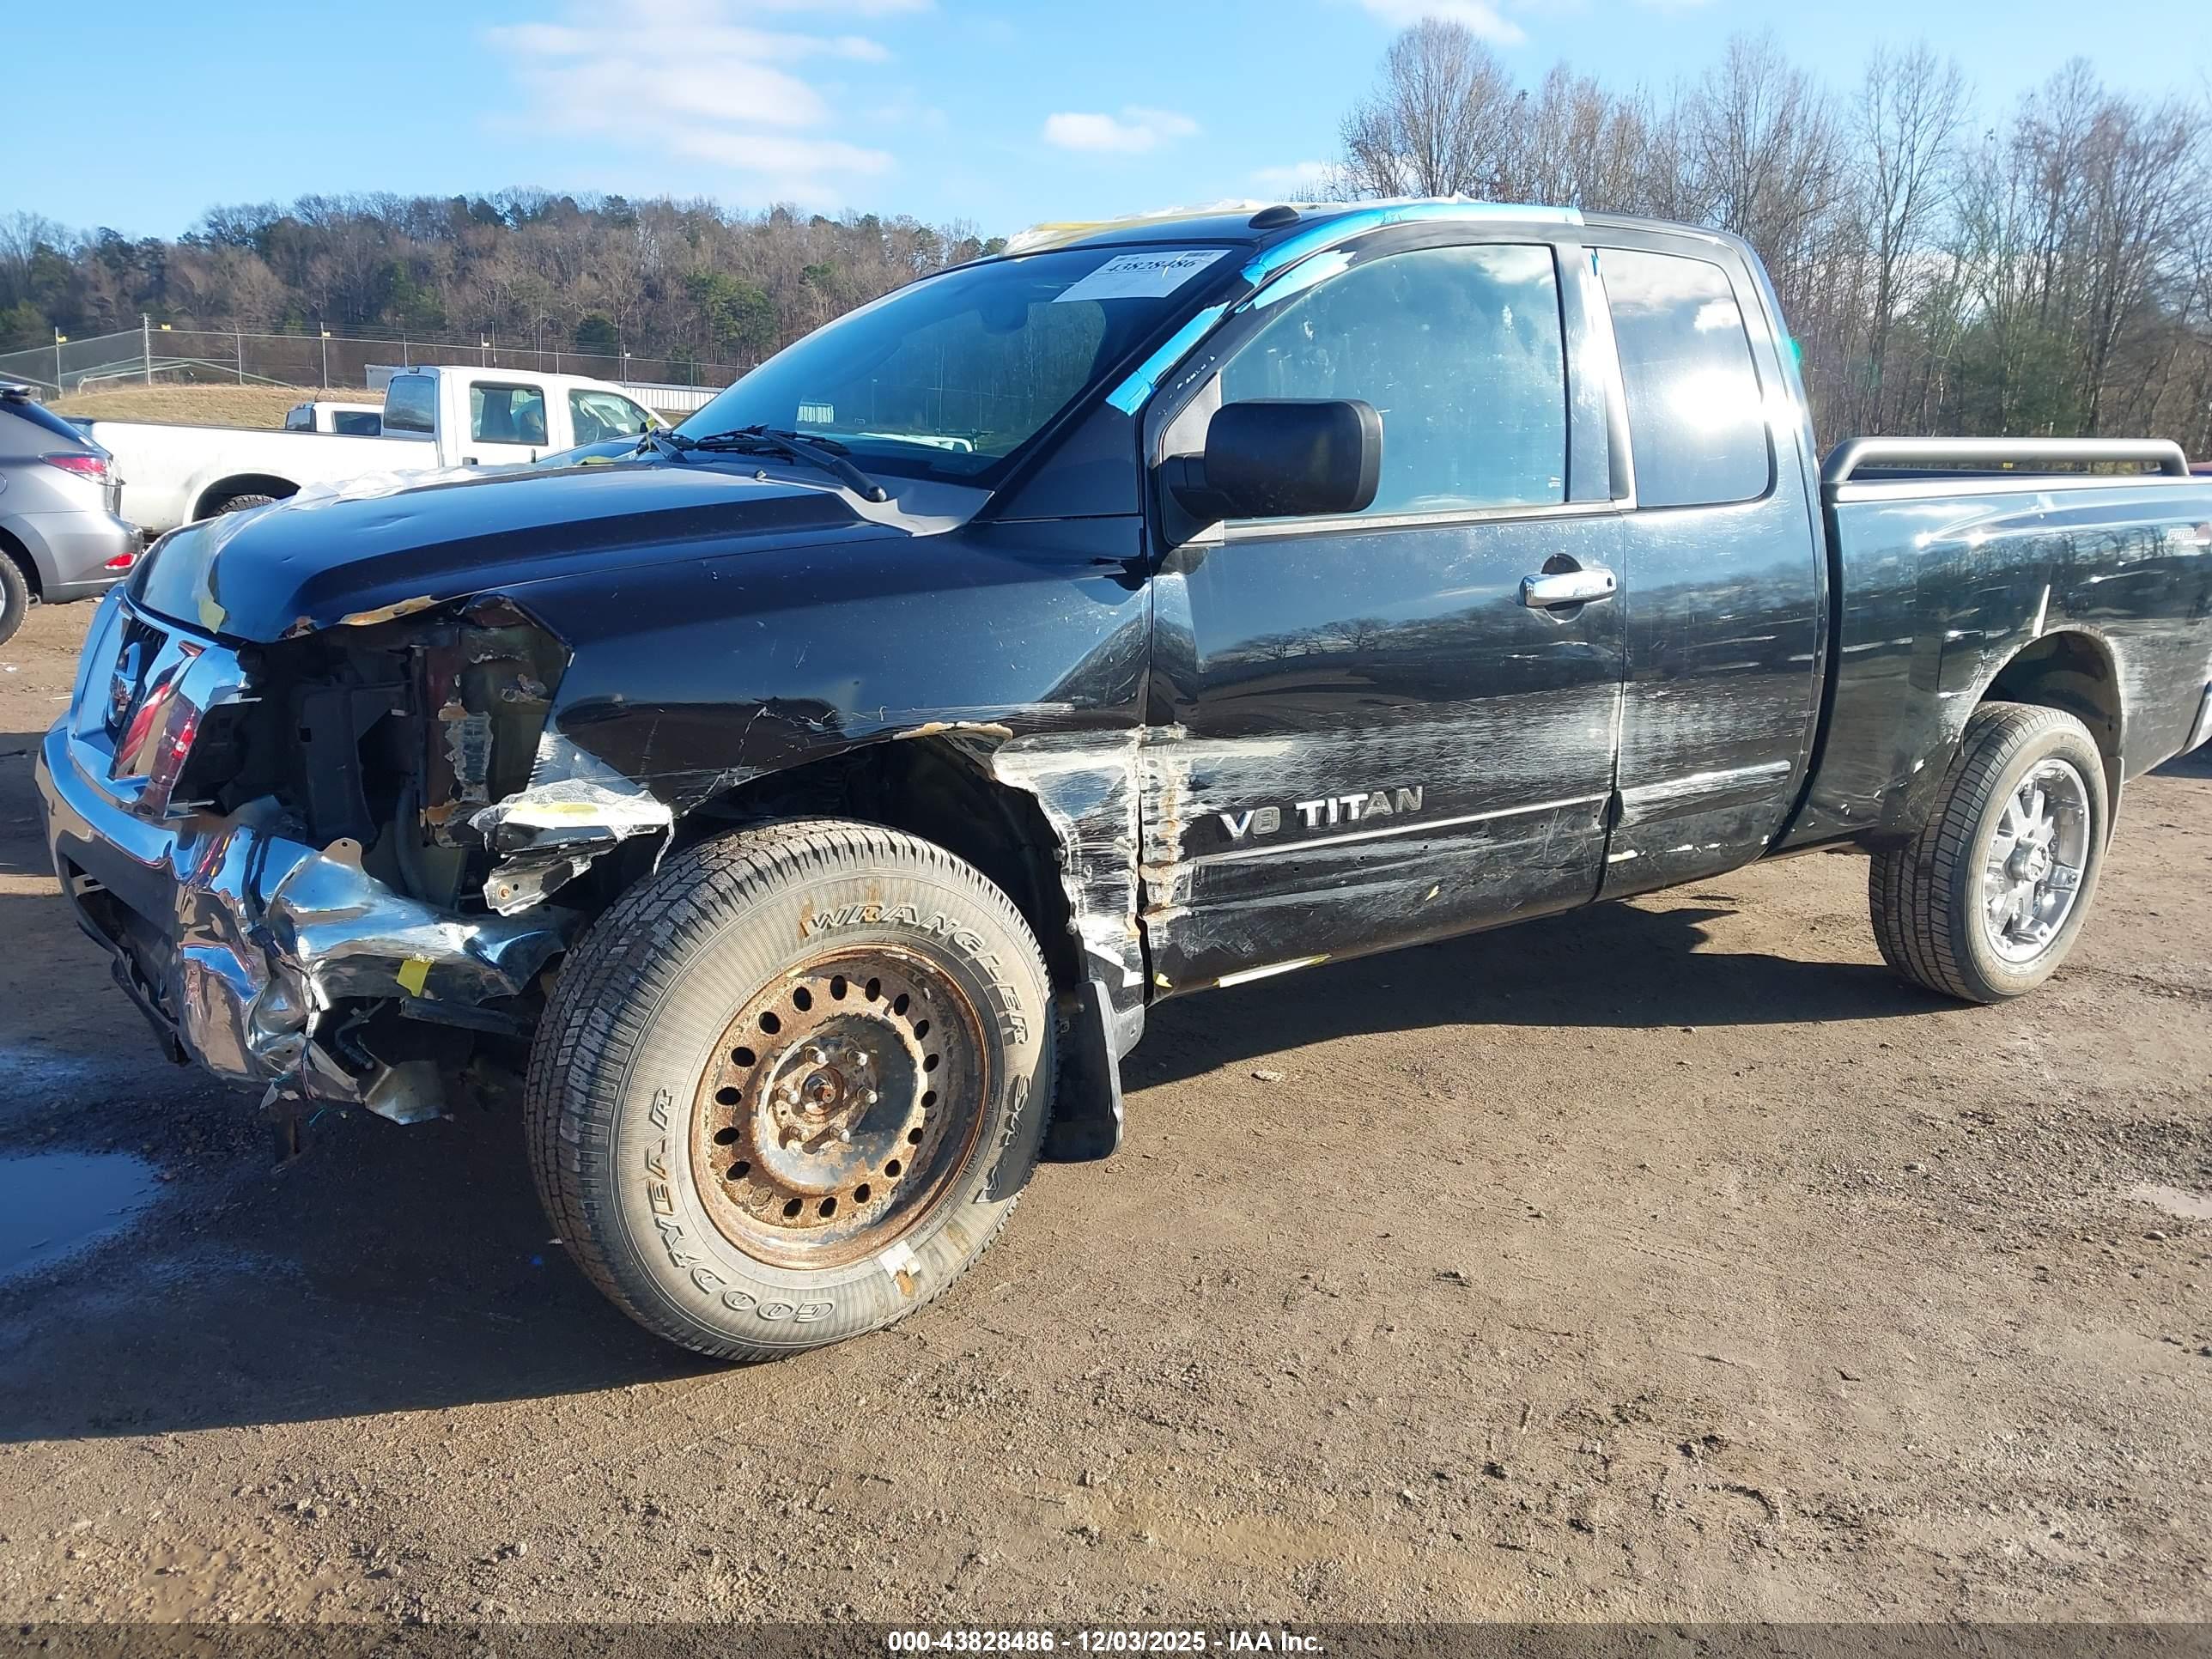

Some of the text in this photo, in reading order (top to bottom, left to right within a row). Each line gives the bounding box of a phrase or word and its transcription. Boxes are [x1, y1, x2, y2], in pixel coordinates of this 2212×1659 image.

[1105, 259, 1196, 272] 43828486
[1219, 785, 1424, 839] V8 TITAN
[802, 901, 1032, 1045] WRANGLER
[641, 1086, 835, 1323] GOODYEAR
